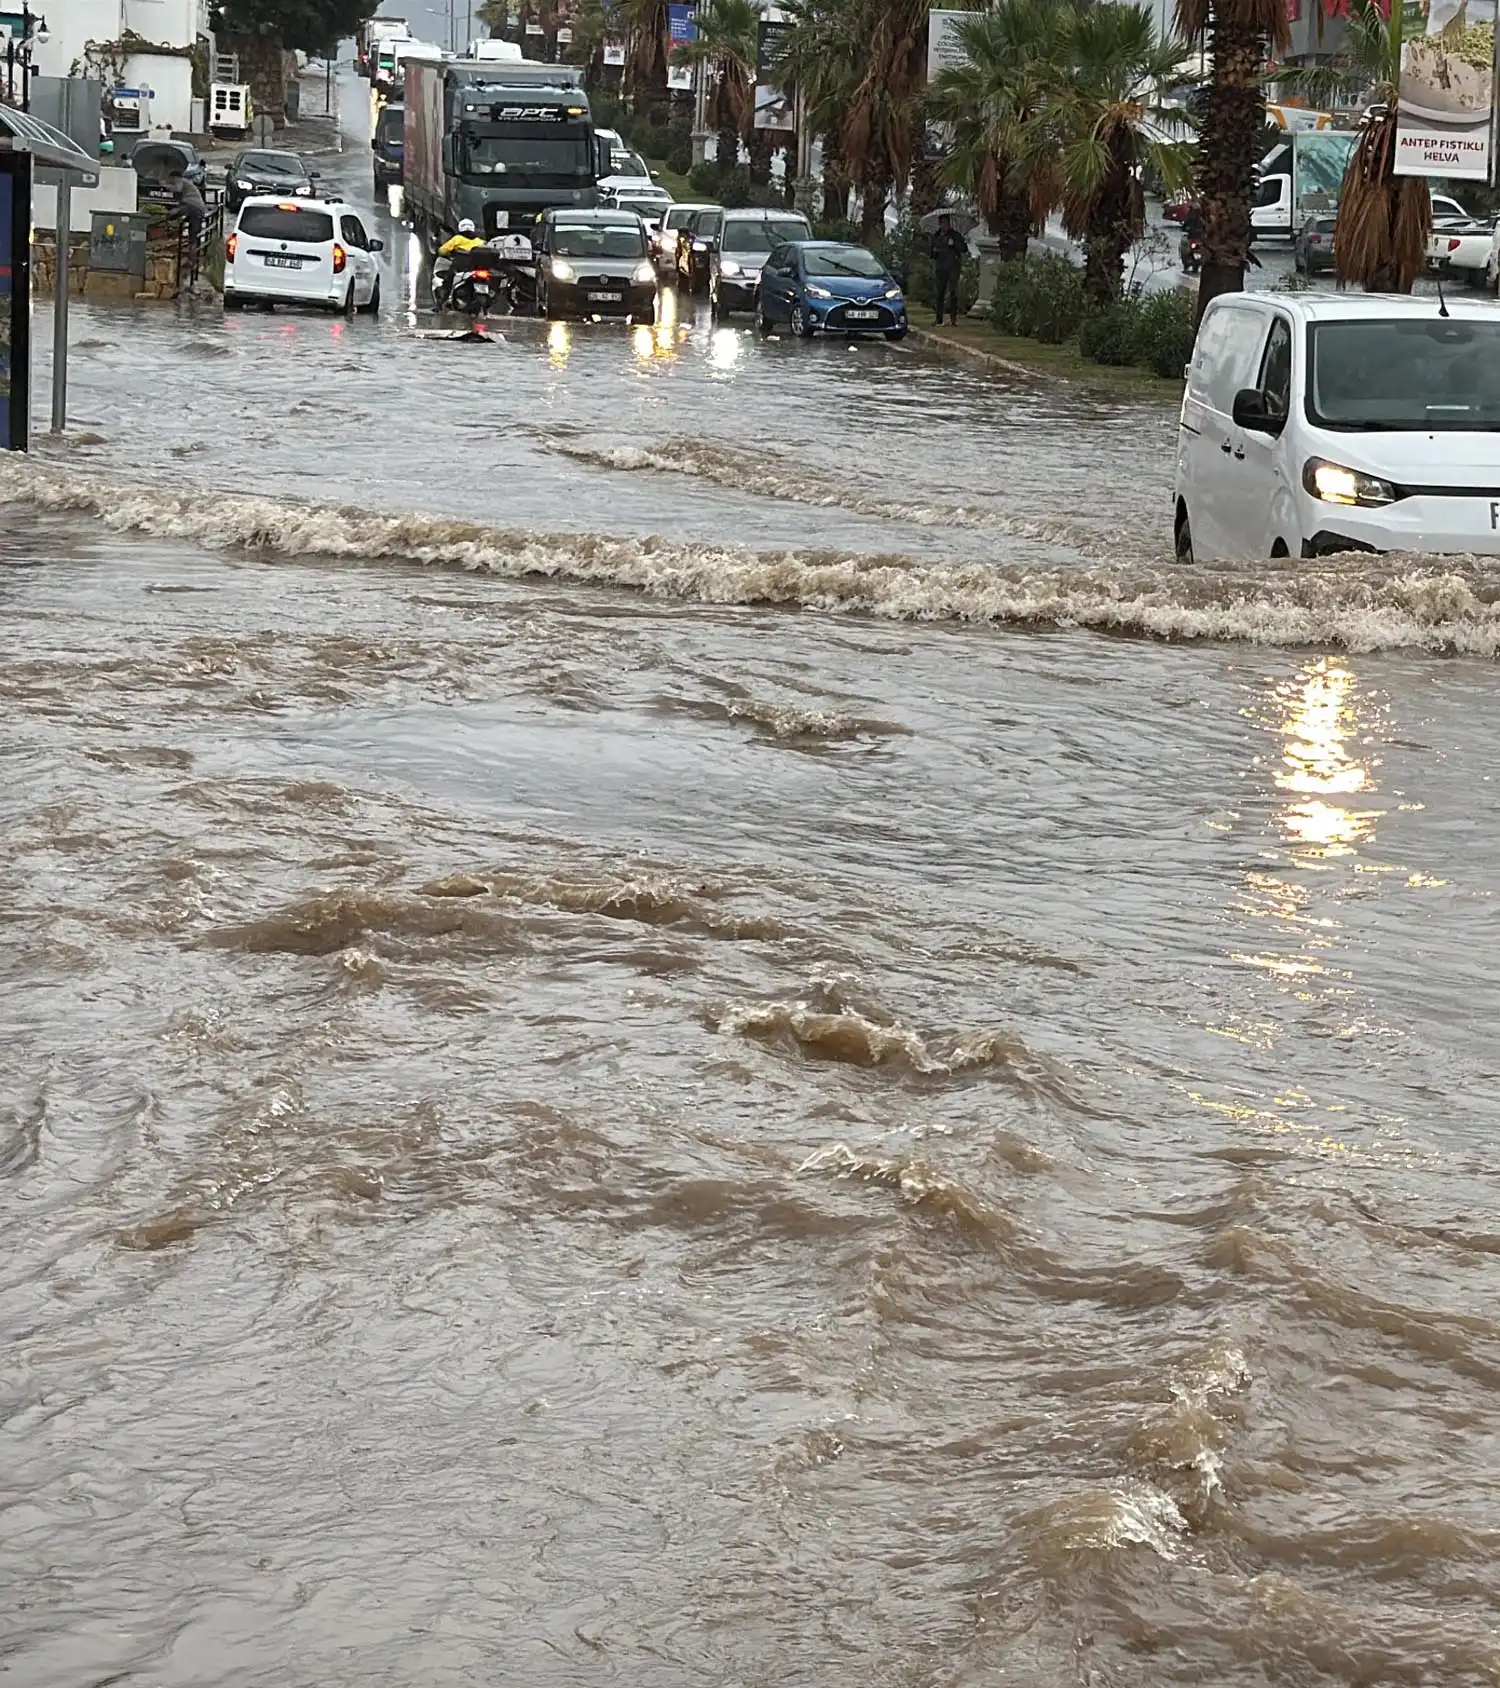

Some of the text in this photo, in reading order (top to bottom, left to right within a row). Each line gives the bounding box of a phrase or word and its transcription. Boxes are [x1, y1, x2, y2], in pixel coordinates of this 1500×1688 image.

[1400, 137, 1484, 151] ANTEP FISTIKLI
[1424, 151, 1460, 163] HELVA
